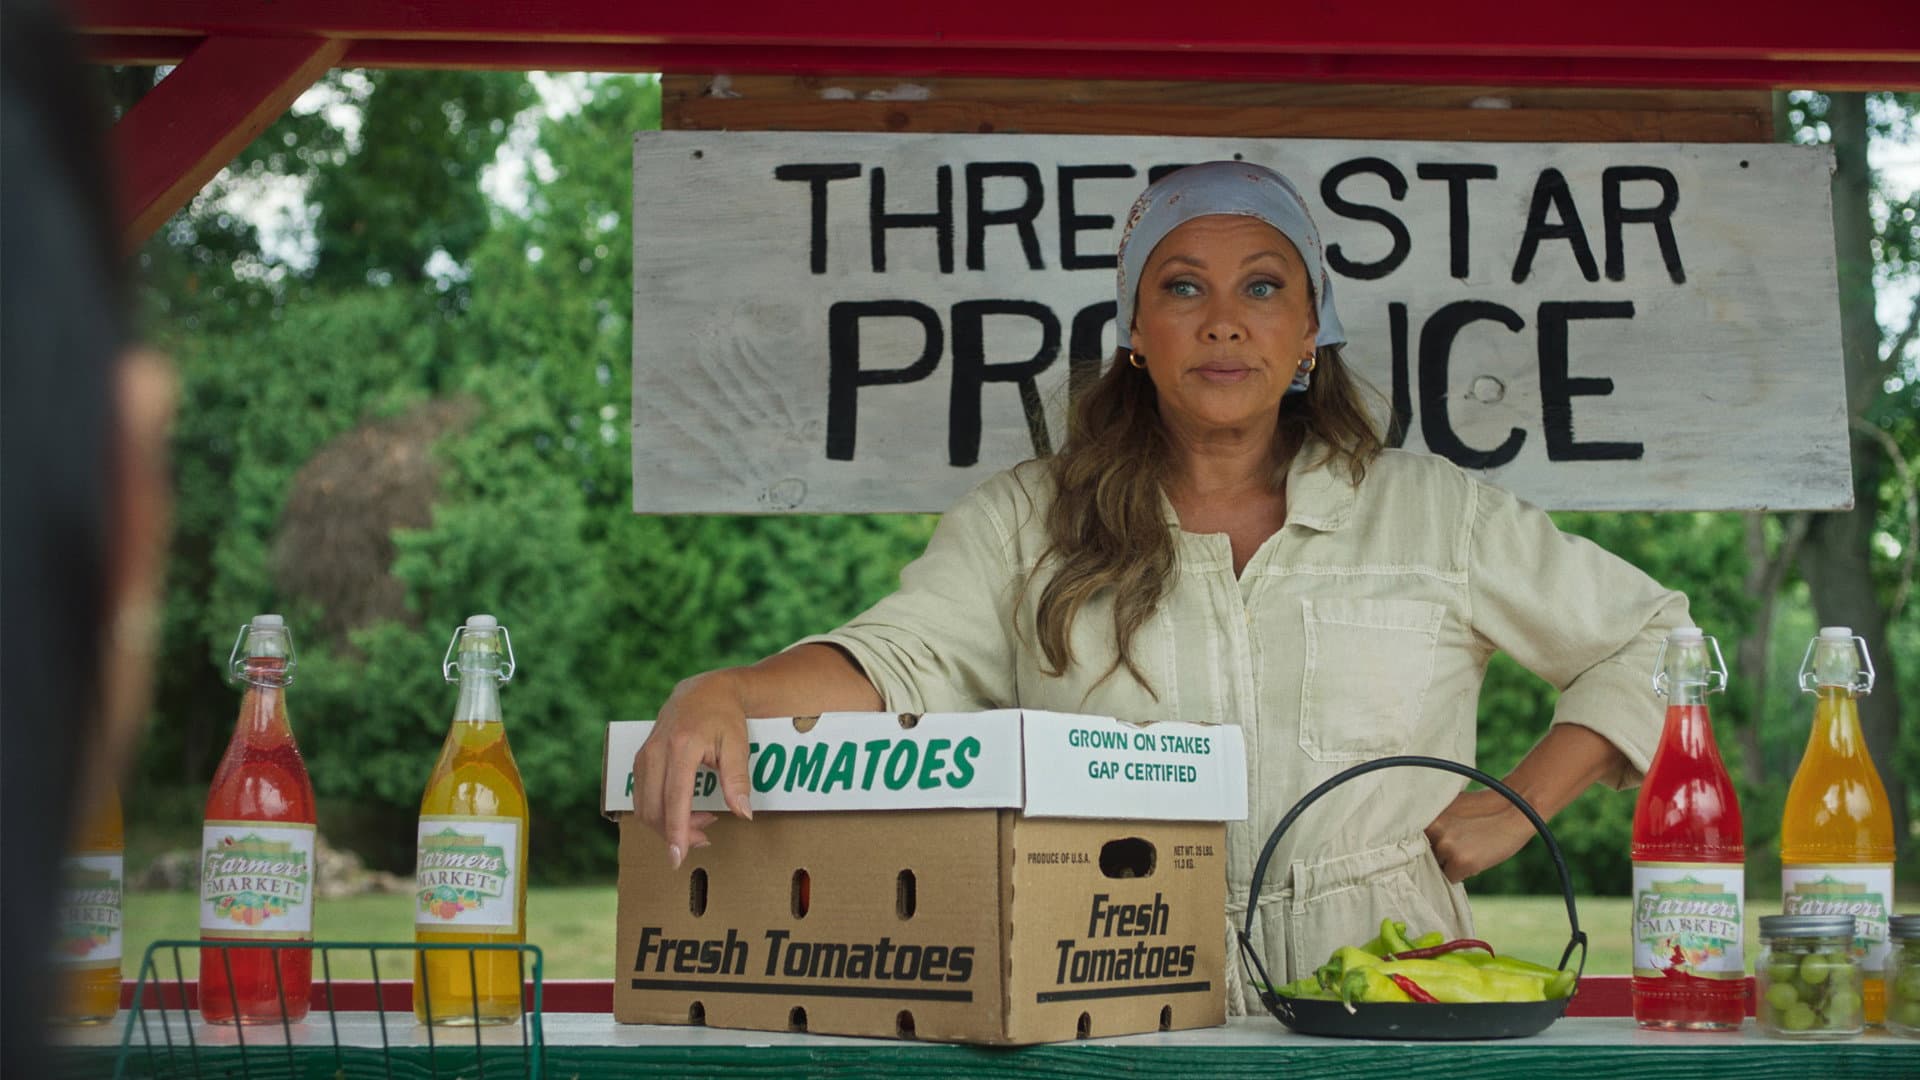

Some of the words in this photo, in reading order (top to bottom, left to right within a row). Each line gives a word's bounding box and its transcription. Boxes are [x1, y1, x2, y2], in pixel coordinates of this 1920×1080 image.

[774, 161, 1204, 274] THRE
[1319, 156, 1687, 285] STAR
[826, 299, 1645, 469] PRCE
[1068, 728, 1128, 750] GROWN
[1133, 733, 1157, 751] ON
[1160, 735, 1211, 755] STAKES
[1088, 760, 1120, 780] GAP
[1124, 762, 1197, 783] CERTIFIED
[206, 853, 303, 882] Farmers
[1027, 852, 1060, 865] PRODUCE
[1061, 852, 1070, 865] OF
[1071, 852, 1091, 865] U.S.A.
[213, 876, 294, 895] MARKET
[1087, 892, 1170, 938] Fresh
[1640, 894, 1736, 922] Farmers
[1648, 918, 1729, 936] MARKET
[634, 926, 749, 976] Fresh
[764, 929, 975, 983] Tomatoes
[1056, 939, 1196, 985] Tomatoes
